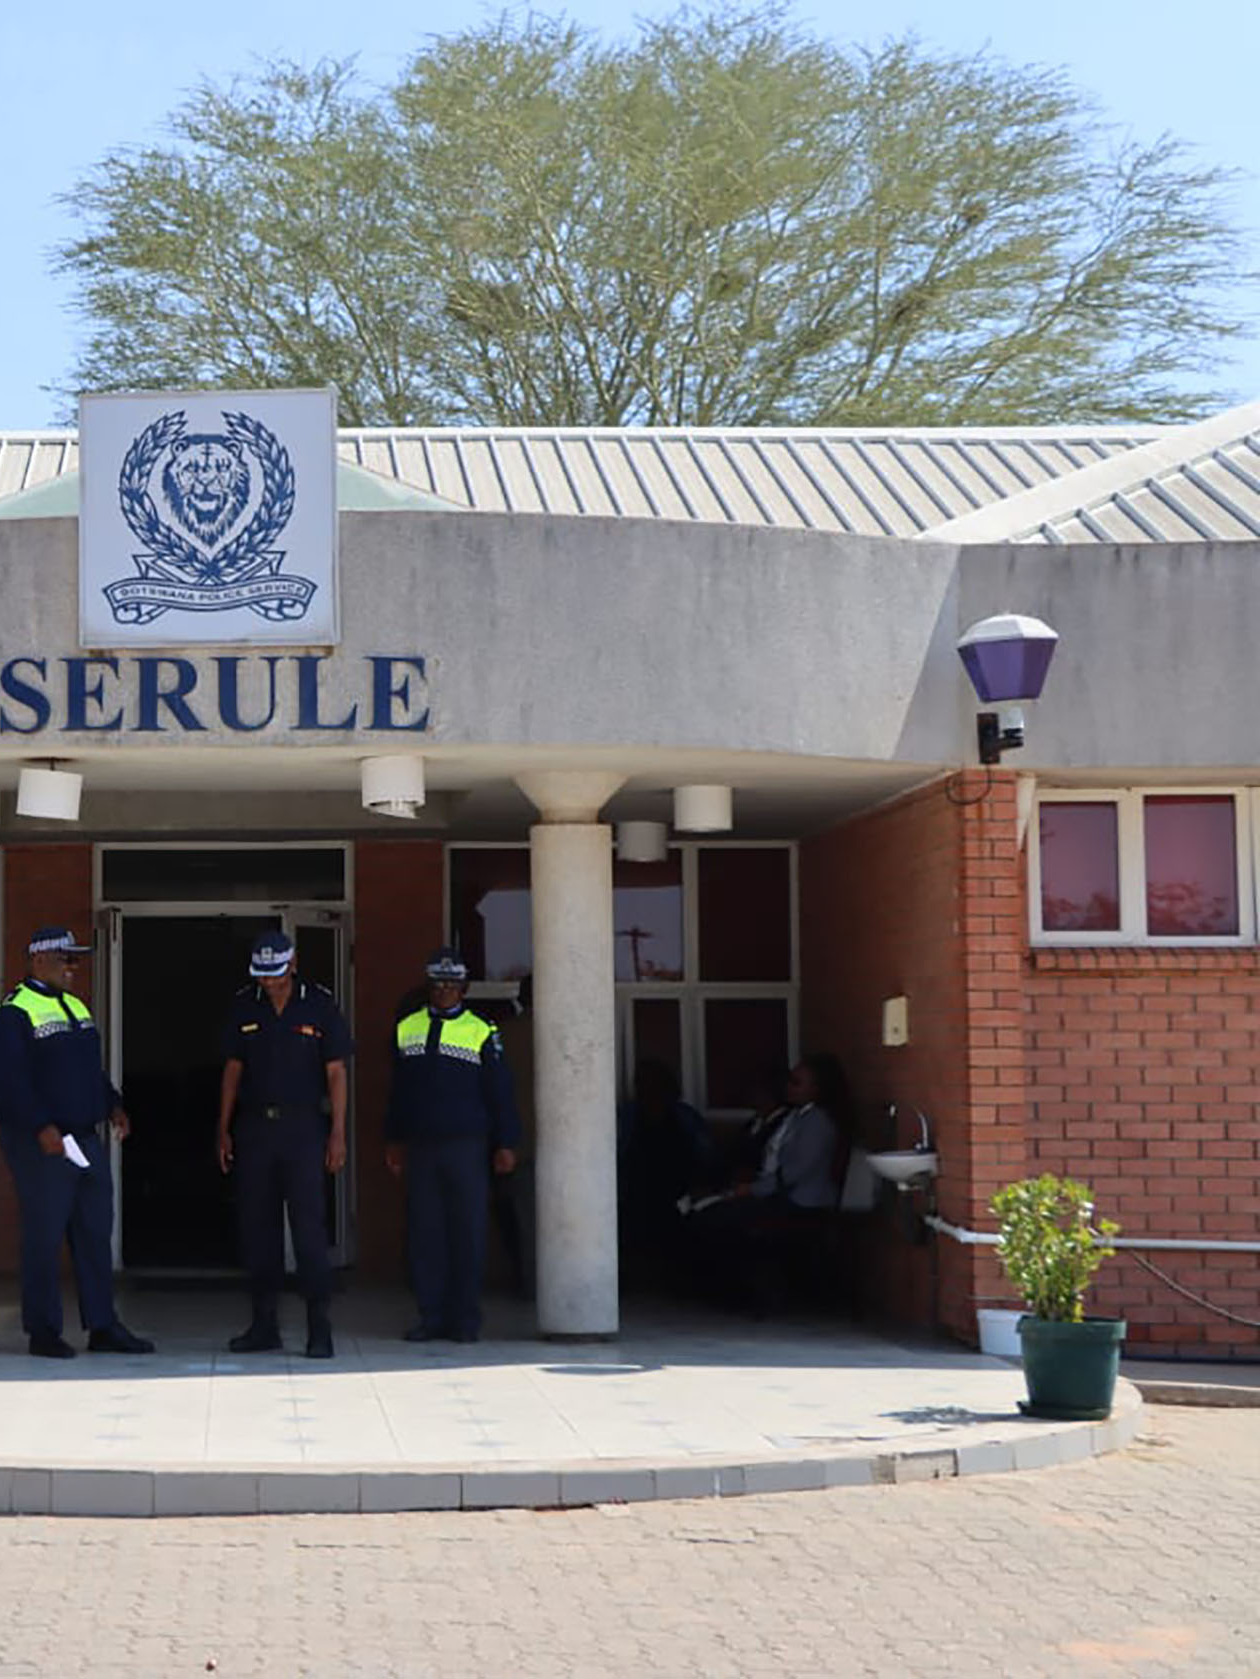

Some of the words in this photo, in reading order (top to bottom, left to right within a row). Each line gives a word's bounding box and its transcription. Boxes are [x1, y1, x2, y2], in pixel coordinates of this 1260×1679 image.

[120, 586, 195, 601] BOTSWANA
[199, 588, 243, 601] POLICE
[247, 584, 303, 598] SERVICE
[0, 656, 430, 734] SERULE
